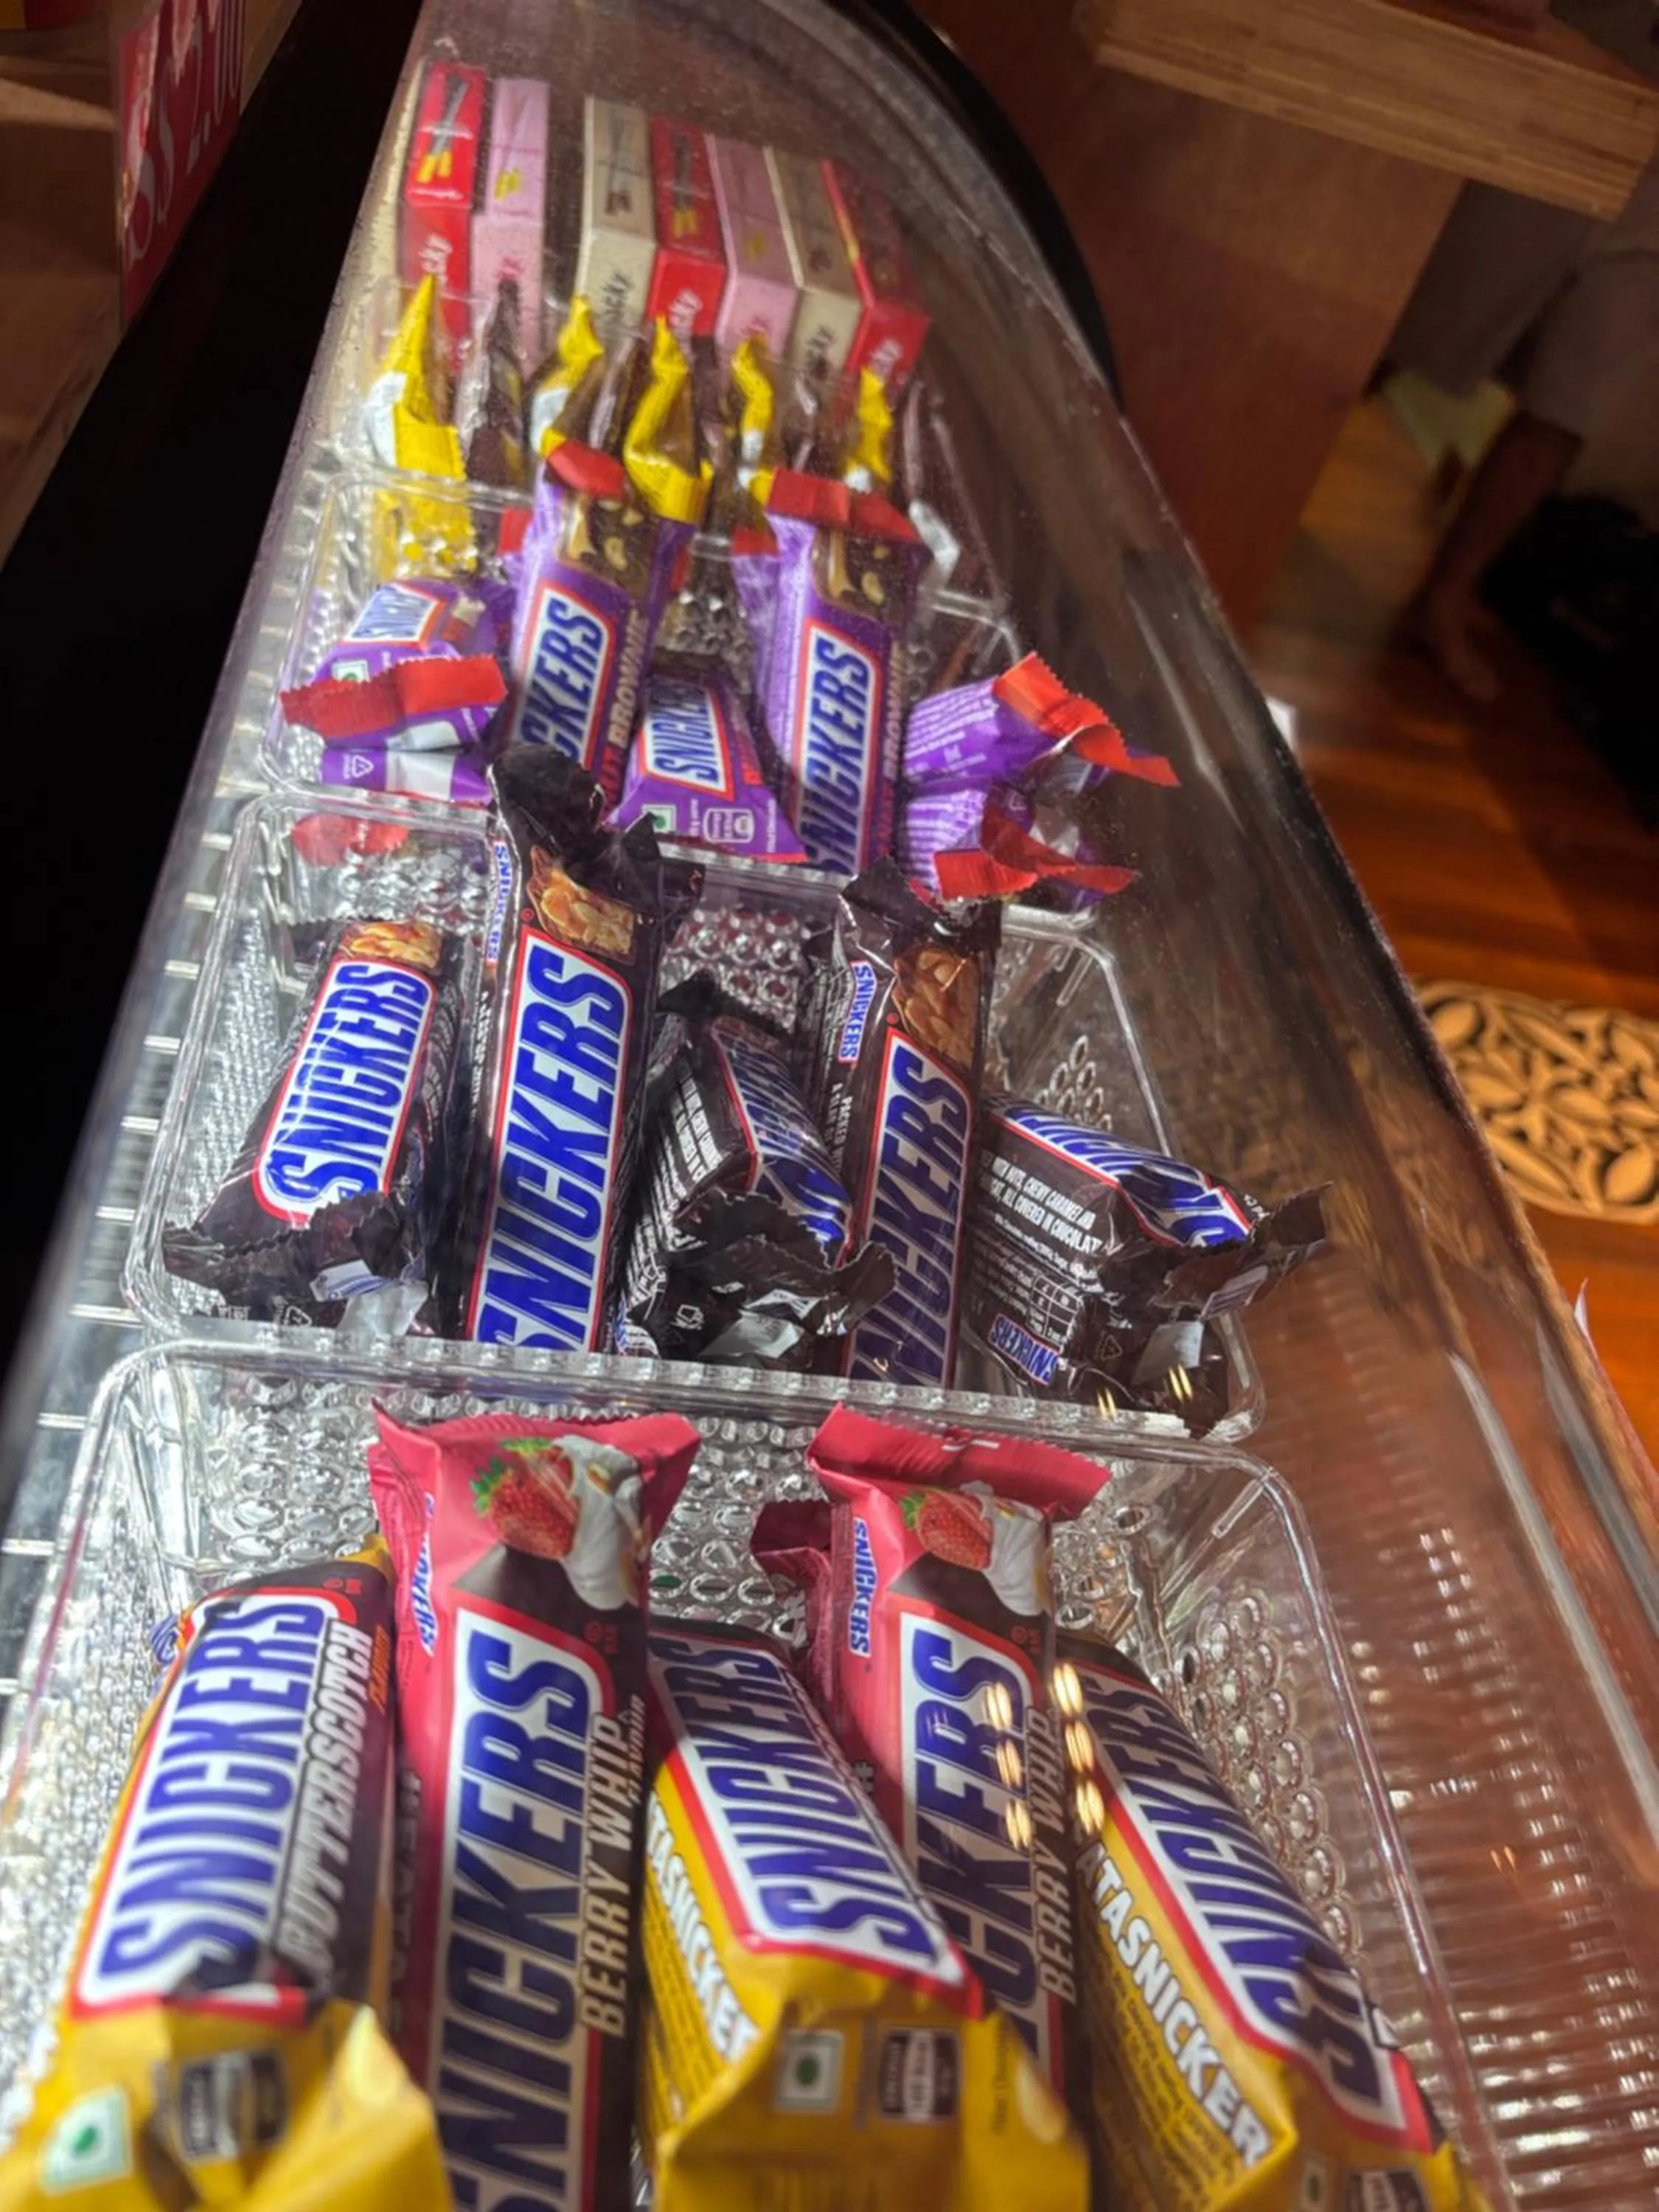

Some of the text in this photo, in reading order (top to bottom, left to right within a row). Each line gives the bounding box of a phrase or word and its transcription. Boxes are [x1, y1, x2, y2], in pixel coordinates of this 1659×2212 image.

[521, 597, 605, 765] CKERS
[265, 964, 431, 1203] SNICKERS
[841, 964, 877, 1058] SNICKERS
[850, 1519, 877, 1653] SNICKERS
[100, 1596, 324, 1986] SNICKERS
[277, 1620, 373, 1970] BUTTERSCOTCH
[580, 1712, 633, 2037] BERRY WHIP
[651, 1635, 936, 1961] SNICKERS
[1034, 1847, 1077, 2006] BERRY
[1077, 1839, 1270, 2166] ATASNICKER
